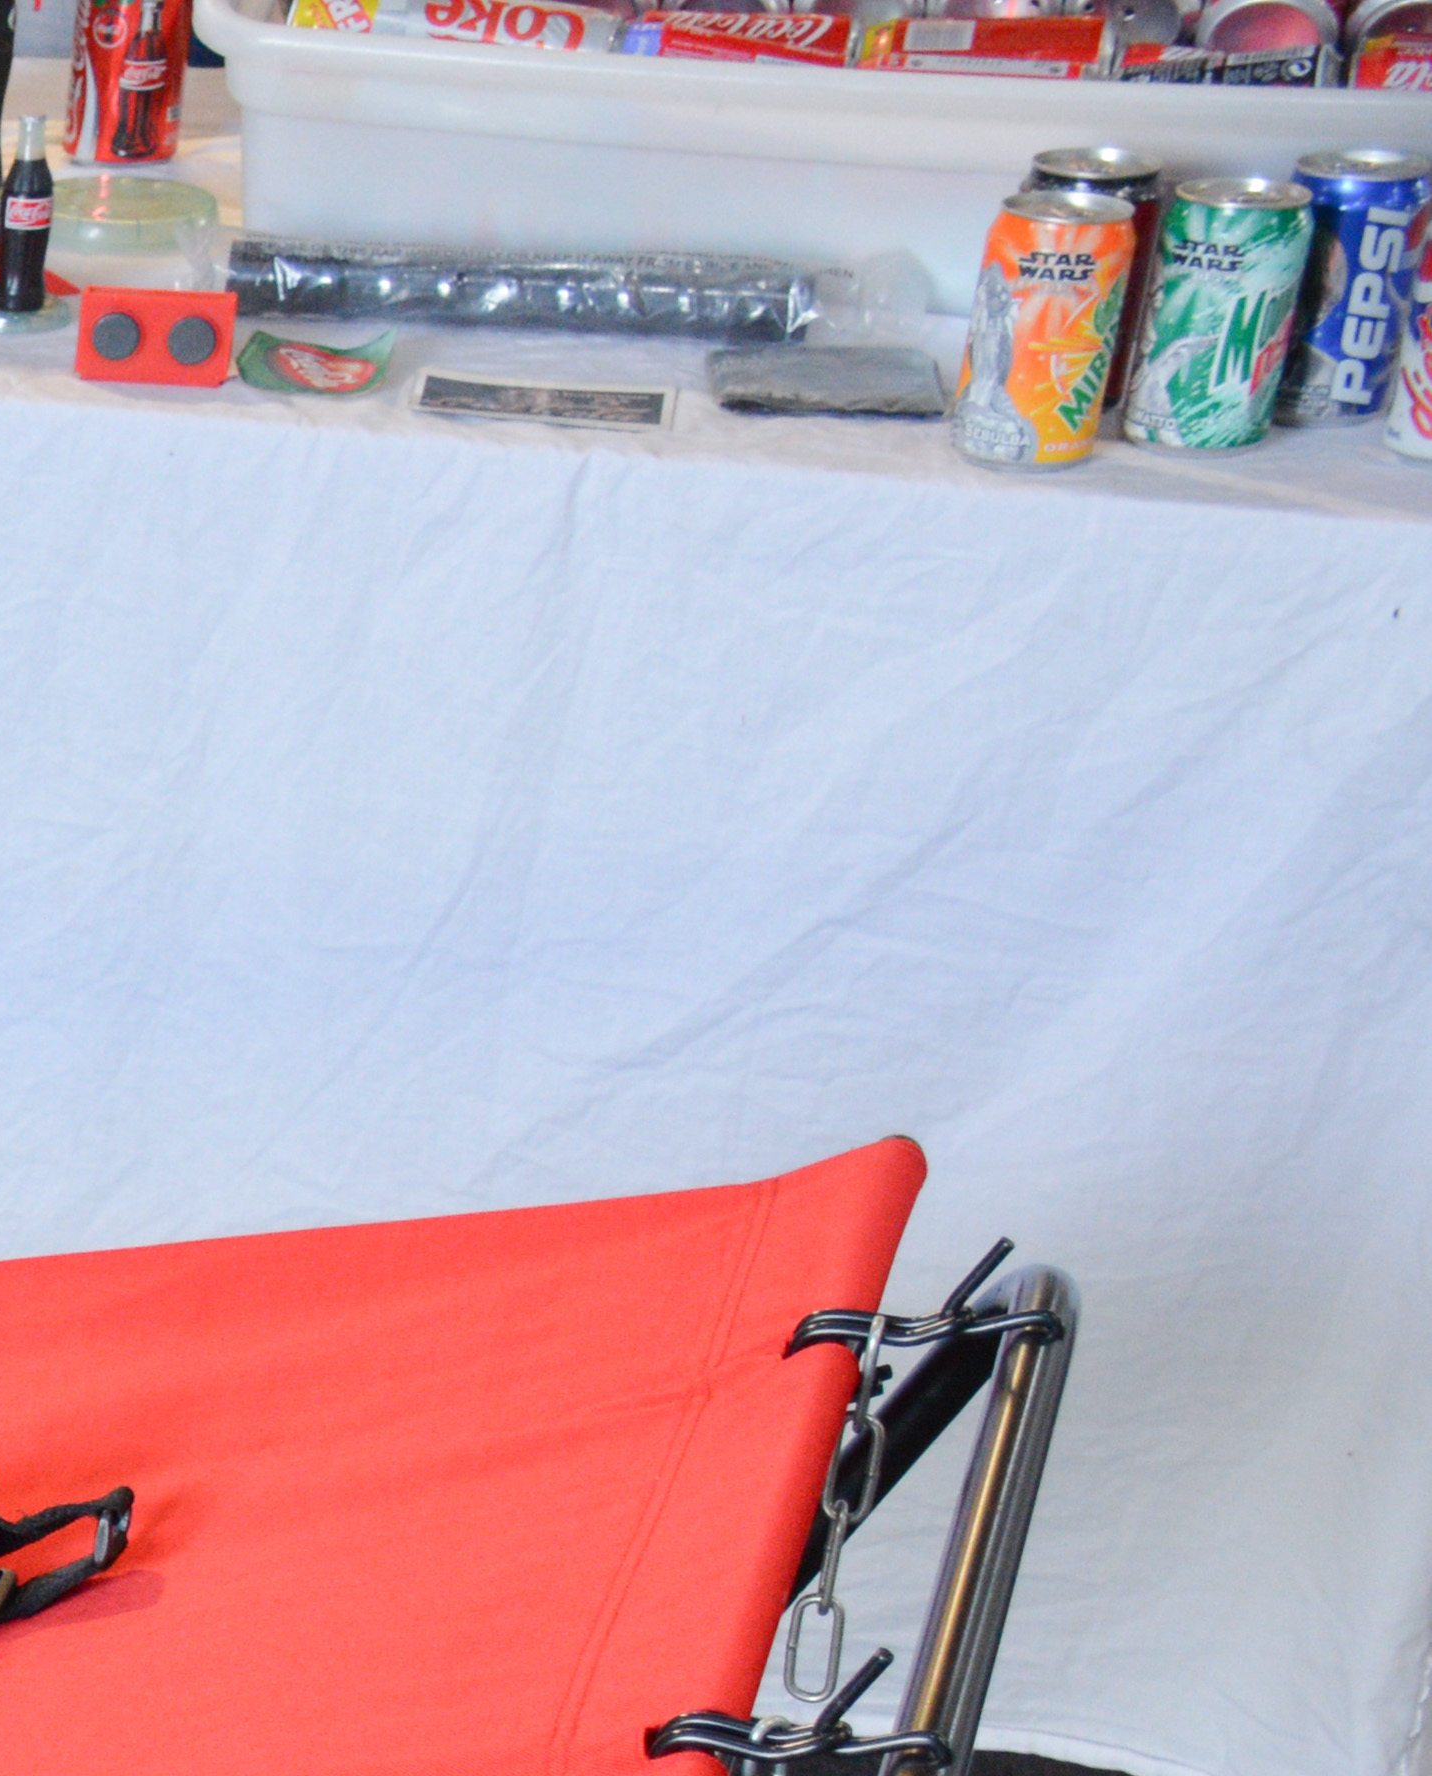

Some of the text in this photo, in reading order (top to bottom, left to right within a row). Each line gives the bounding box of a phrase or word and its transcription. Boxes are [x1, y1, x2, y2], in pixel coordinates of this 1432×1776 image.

[425, 0, 584, 52] Coke
[1173, 239, 1247, 258] STAR
[1018, 251, 1097, 267] STAR
[1172, 253, 1245, 273] WARS
[1017, 264, 1096, 282] WARS
[1331, 206, 1409, 405] PEPSI
